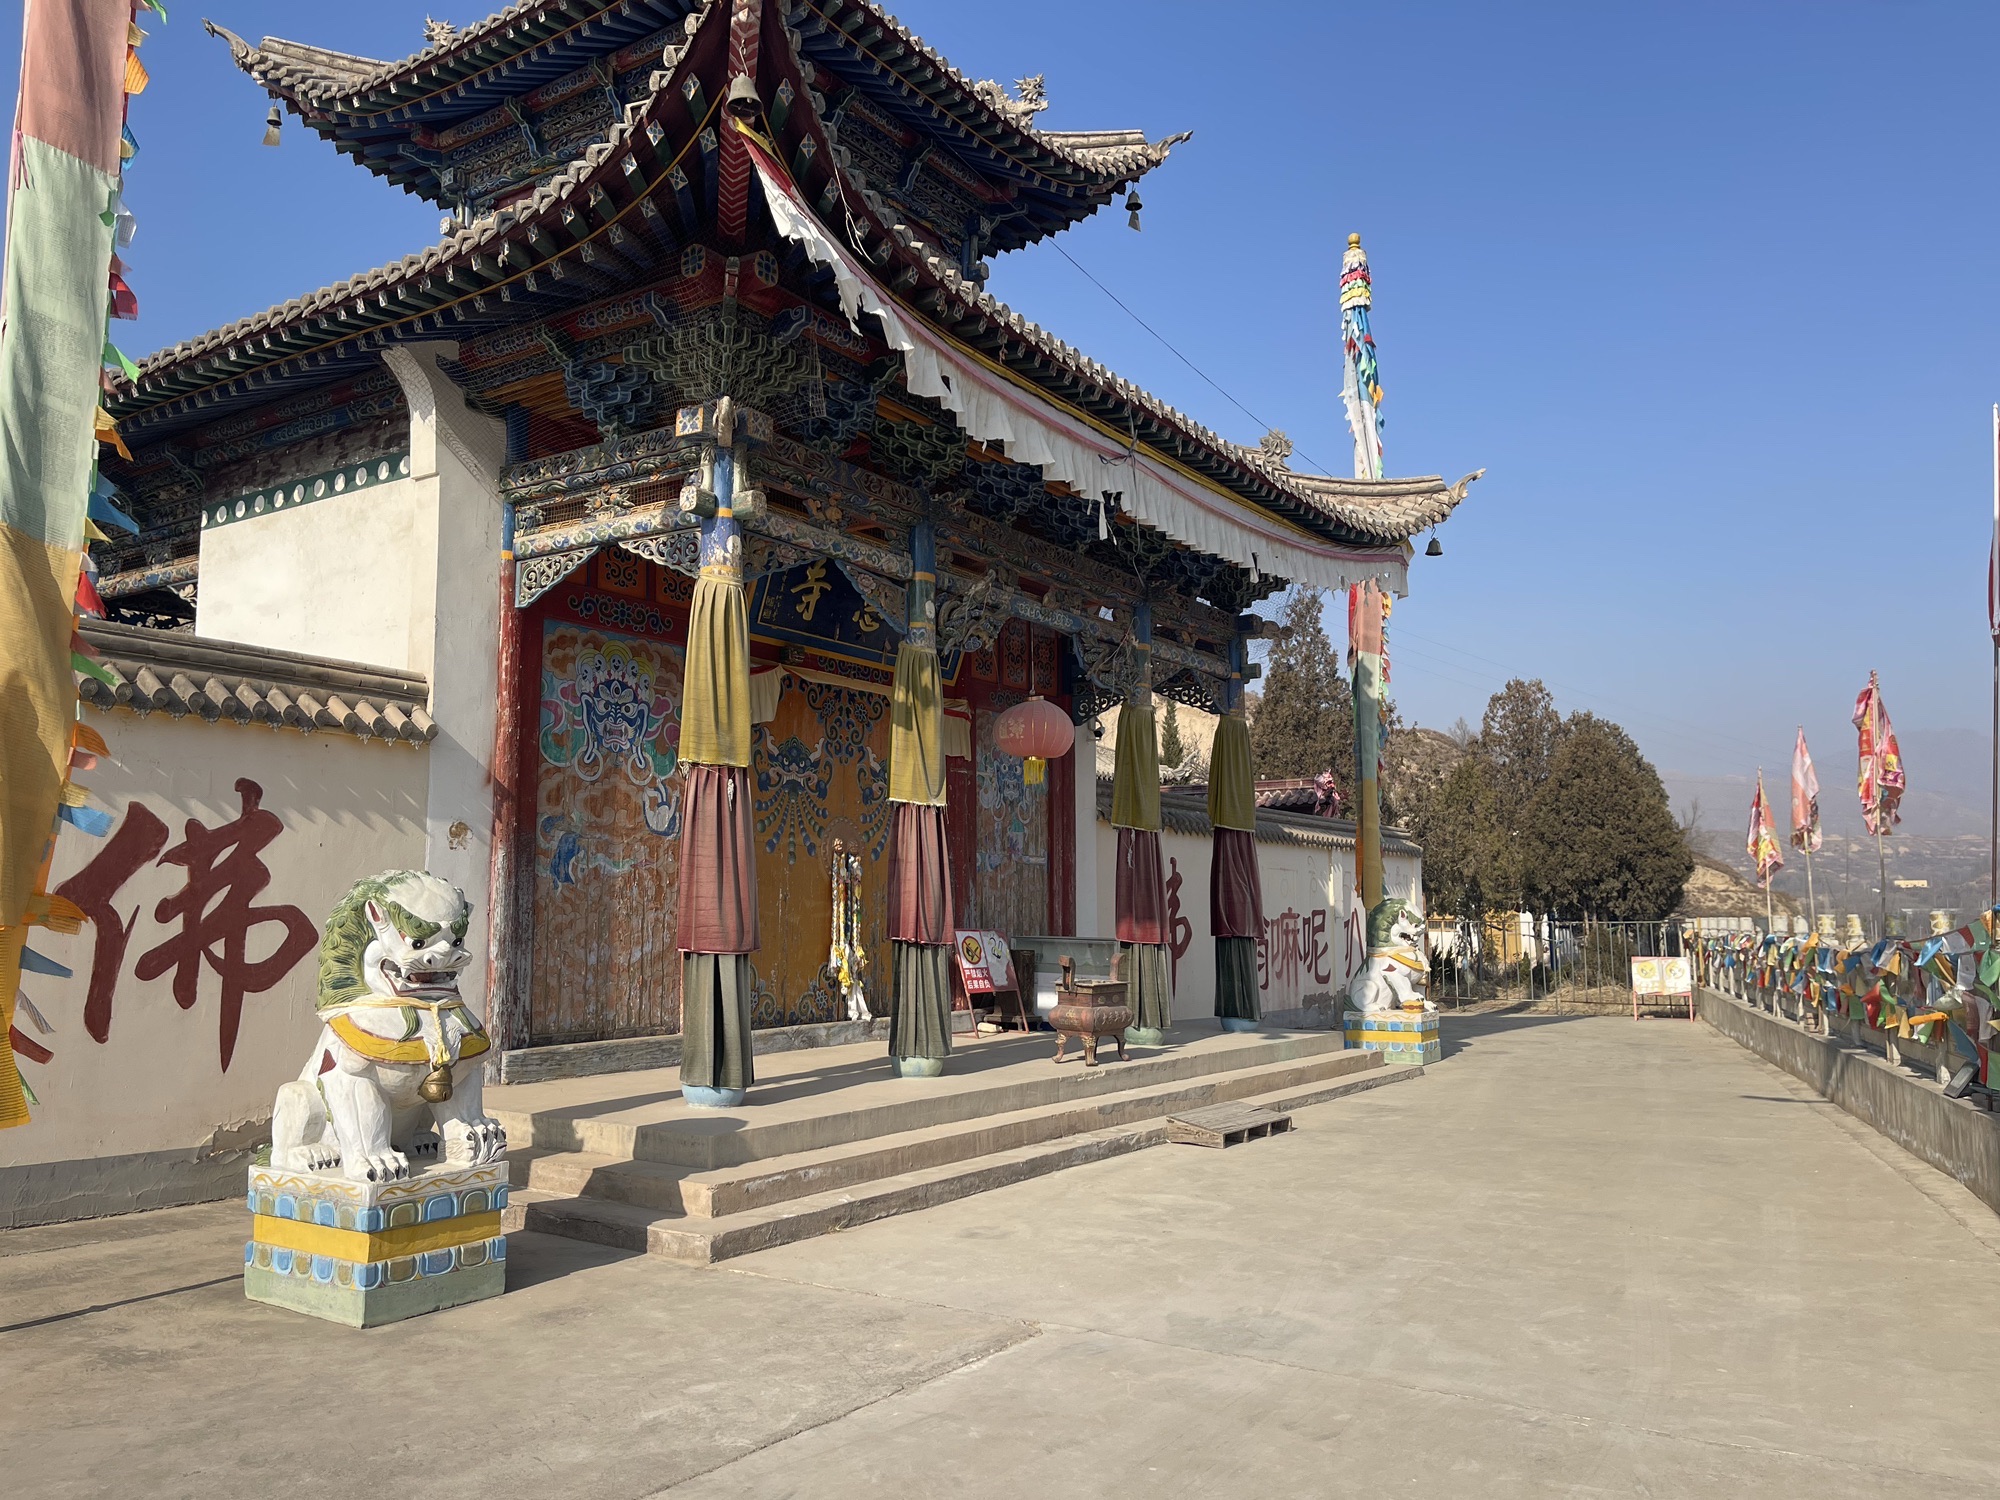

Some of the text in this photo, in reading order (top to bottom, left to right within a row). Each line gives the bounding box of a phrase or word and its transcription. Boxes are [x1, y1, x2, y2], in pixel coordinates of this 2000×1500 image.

[54, 777, 319, 1074] 佛
[964, 969, 988, 979] 严禁烟火
[967, 979, 991, 989] 后果自负
